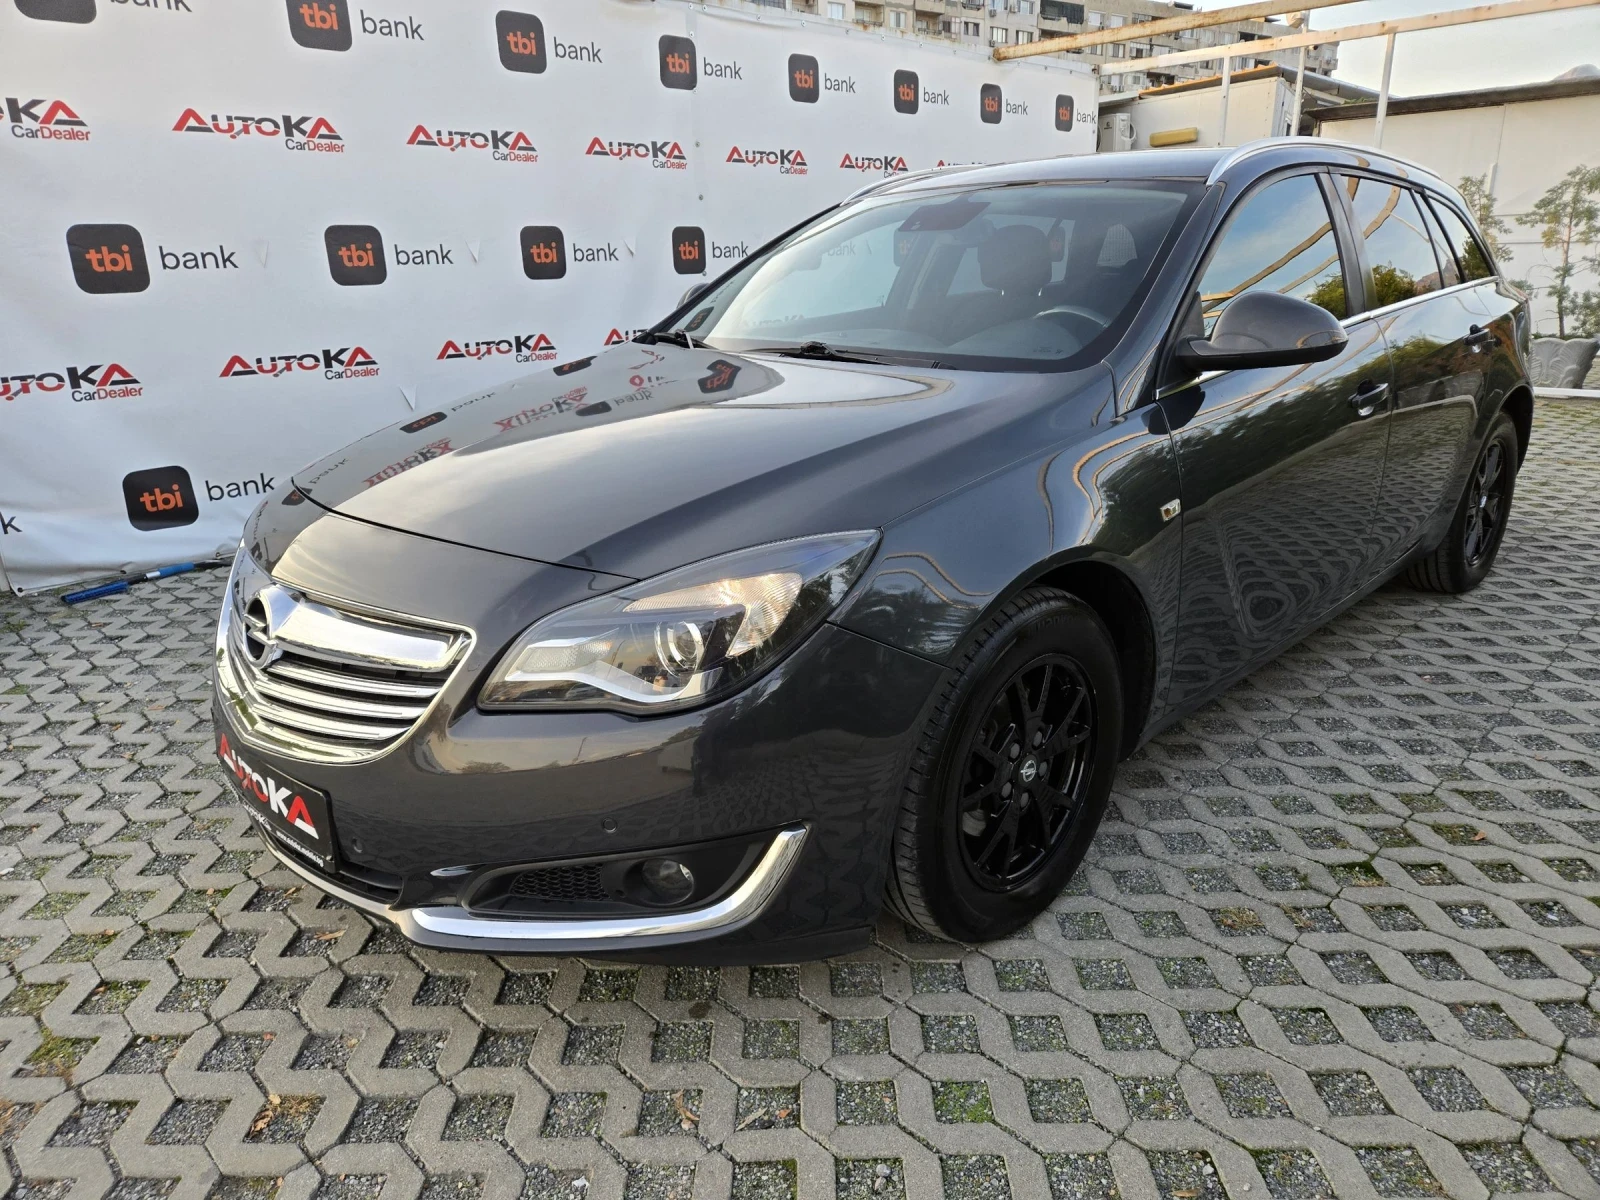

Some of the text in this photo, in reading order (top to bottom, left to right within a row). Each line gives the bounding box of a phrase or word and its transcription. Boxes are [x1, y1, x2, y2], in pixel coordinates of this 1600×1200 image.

[299, 3, 424, 41] tbi bank
[507, 32, 602, 63] tbi bank
[666, 54, 742, 80] tbi bank
[794, 70, 855, 94] tbi bank
[899, 84, 949, 105] tbi bank
[985, 97, 1028, 116] tbi bank
[1059, 107, 1097, 124] tbi bank
[11, 124, 91, 141] CarDealer
[285, 138, 345, 153] CarDealer
[492, 150, 538, 162] CarDealer
[652, 159, 687, 170] CarDealer
[779, 165, 808, 175] CarDealer
[85, 244, 239, 272] tbi bank
[338, 242, 454, 267] tbi bank
[530, 243, 619, 264] tbi bank
[679, 241, 749, 260] tbi bank
[515, 351, 558, 363] CarDealer
[324, 367, 380, 380] CarDealer
[71, 387, 143, 402] CarDealer
[139, 473, 275, 512] tbi bank
